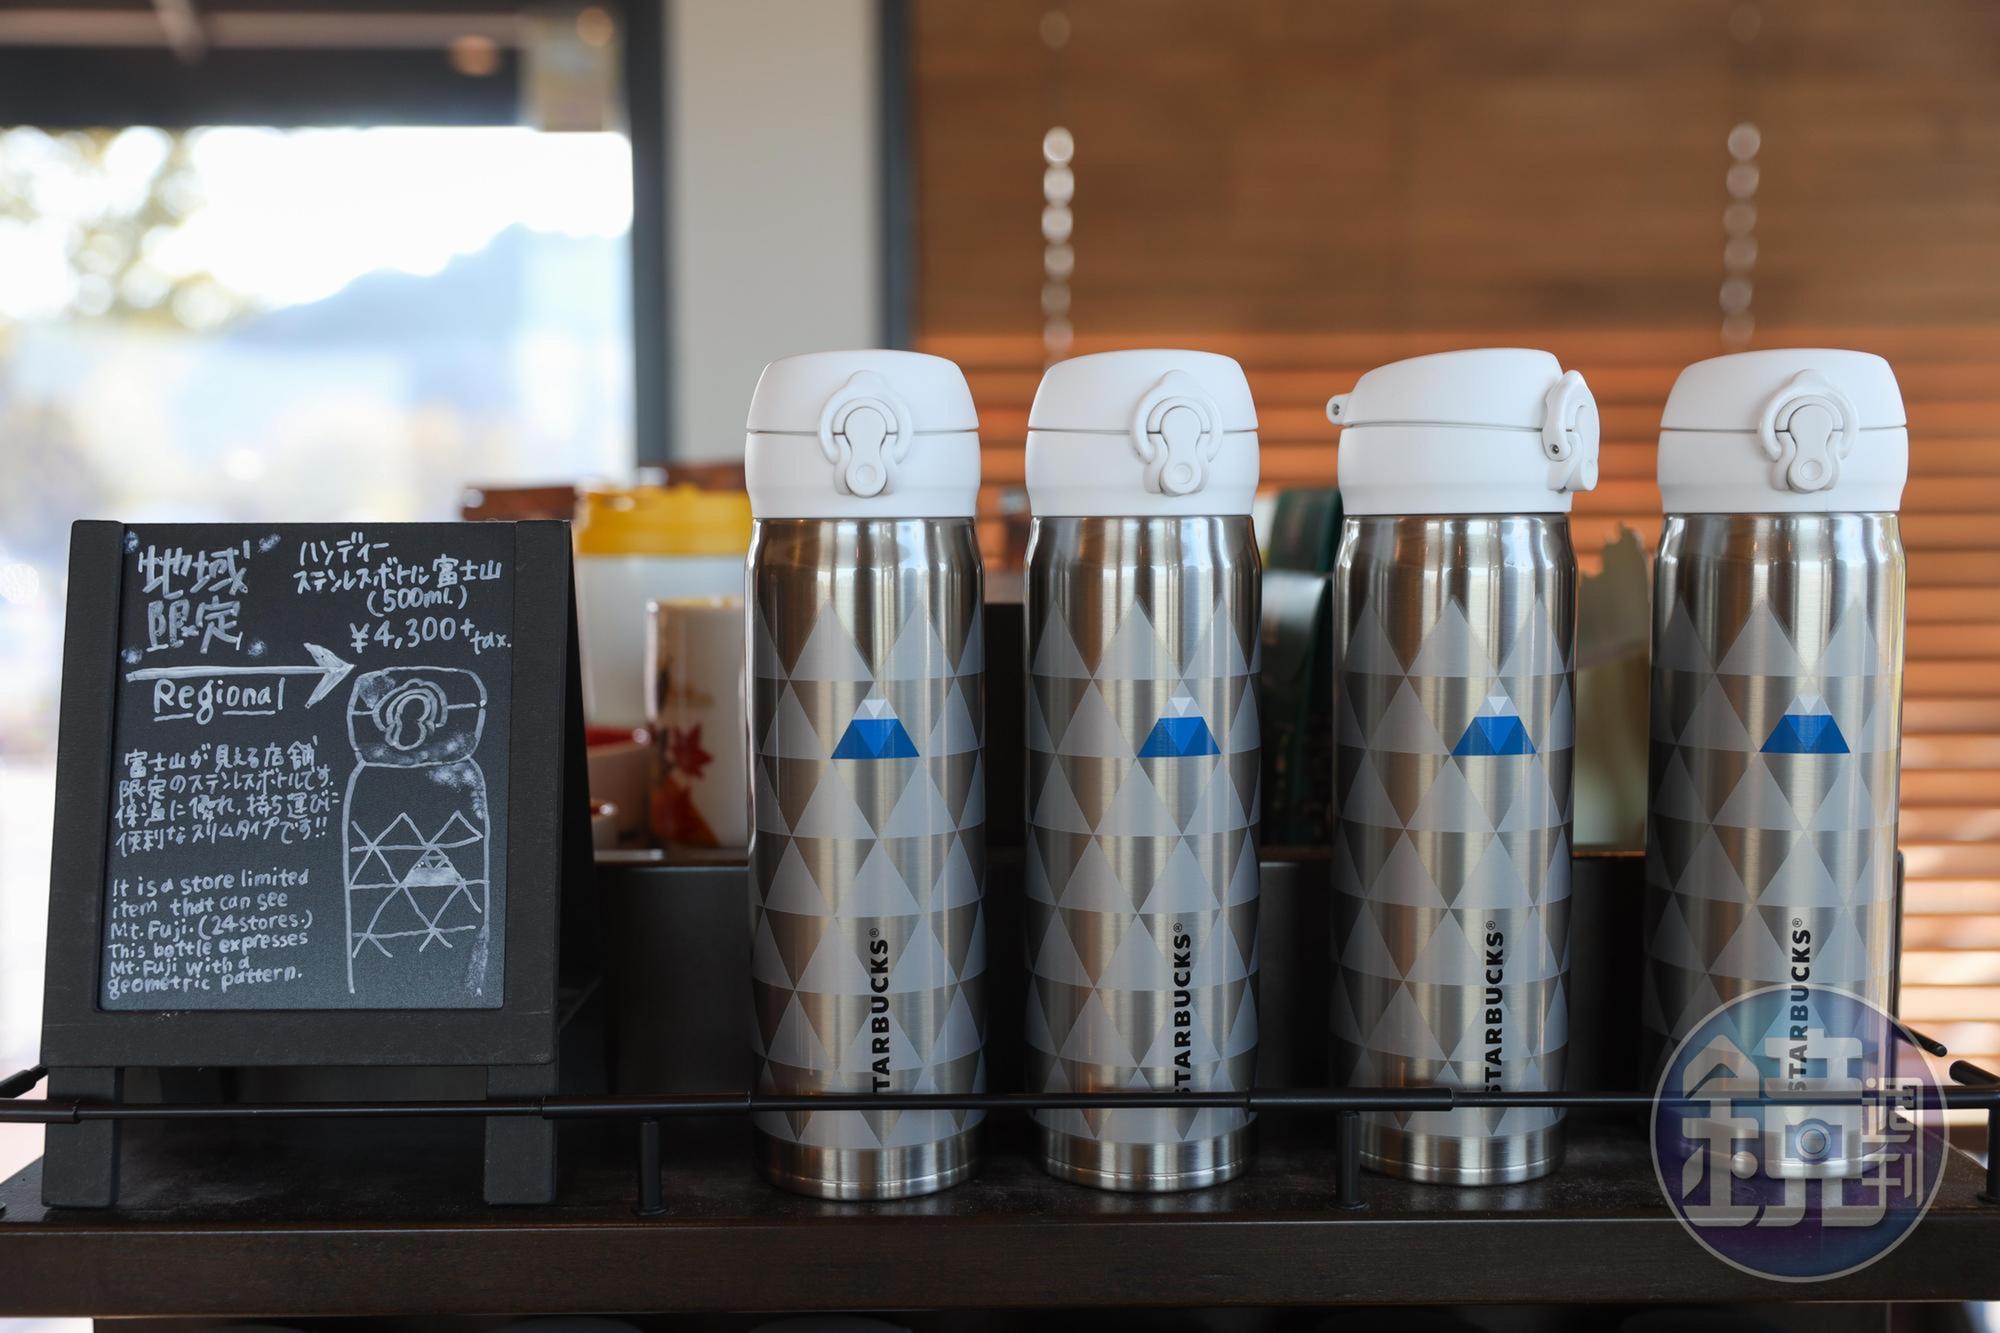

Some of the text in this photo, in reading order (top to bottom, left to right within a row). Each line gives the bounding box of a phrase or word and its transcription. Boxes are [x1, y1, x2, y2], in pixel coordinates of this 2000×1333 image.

[300, 532, 389, 566] ハンディー
[138, 540, 250, 599] 地域
[433, 554, 502, 588] 富士山
[146, 595, 243, 654] 限定
[153, 677, 285, 725] Regional
[113, 867, 309, 897] It is a store limited
[113, 892, 288, 919] item that can see
[108, 932, 308, 958] This bottle expresses
[108, 966, 303, 1000] geometric pattern.
[186, 957, 232, 976] with
[238, 956, 250, 969] a
